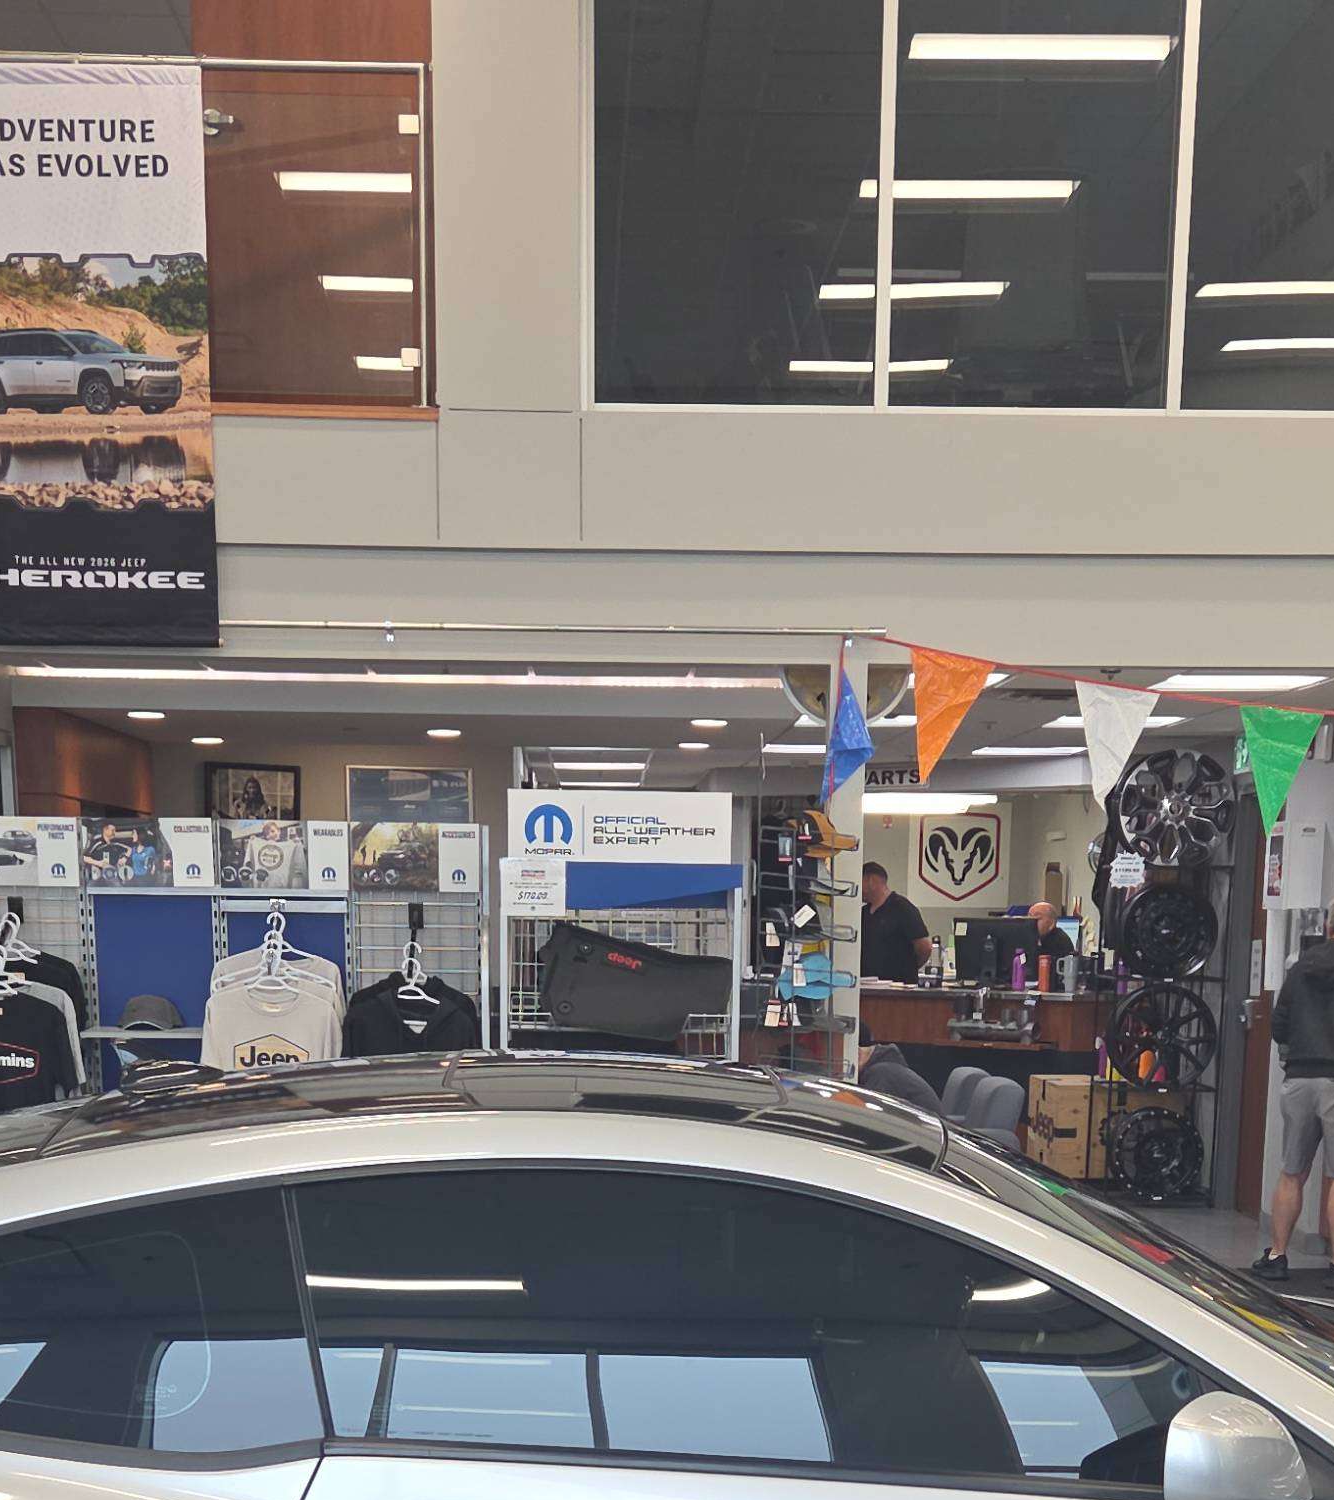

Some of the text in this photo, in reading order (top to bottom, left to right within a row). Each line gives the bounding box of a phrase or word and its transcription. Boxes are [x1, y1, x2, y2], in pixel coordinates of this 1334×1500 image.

[37, 154, 168, 178] EVOLVED
[14, 554, 34, 566] THE
[39, 557, 58, 566] ALL
[63, 557, 85, 566] NEW
[120, 558, 147, 567] JEEP
[865, 769, 921, 785] ARTS
[593, 816, 667, 825] OFFICIAL
[593, 827, 716, 836] ALL-WEATHER
[593, 836, 662, 845] EXPERT
